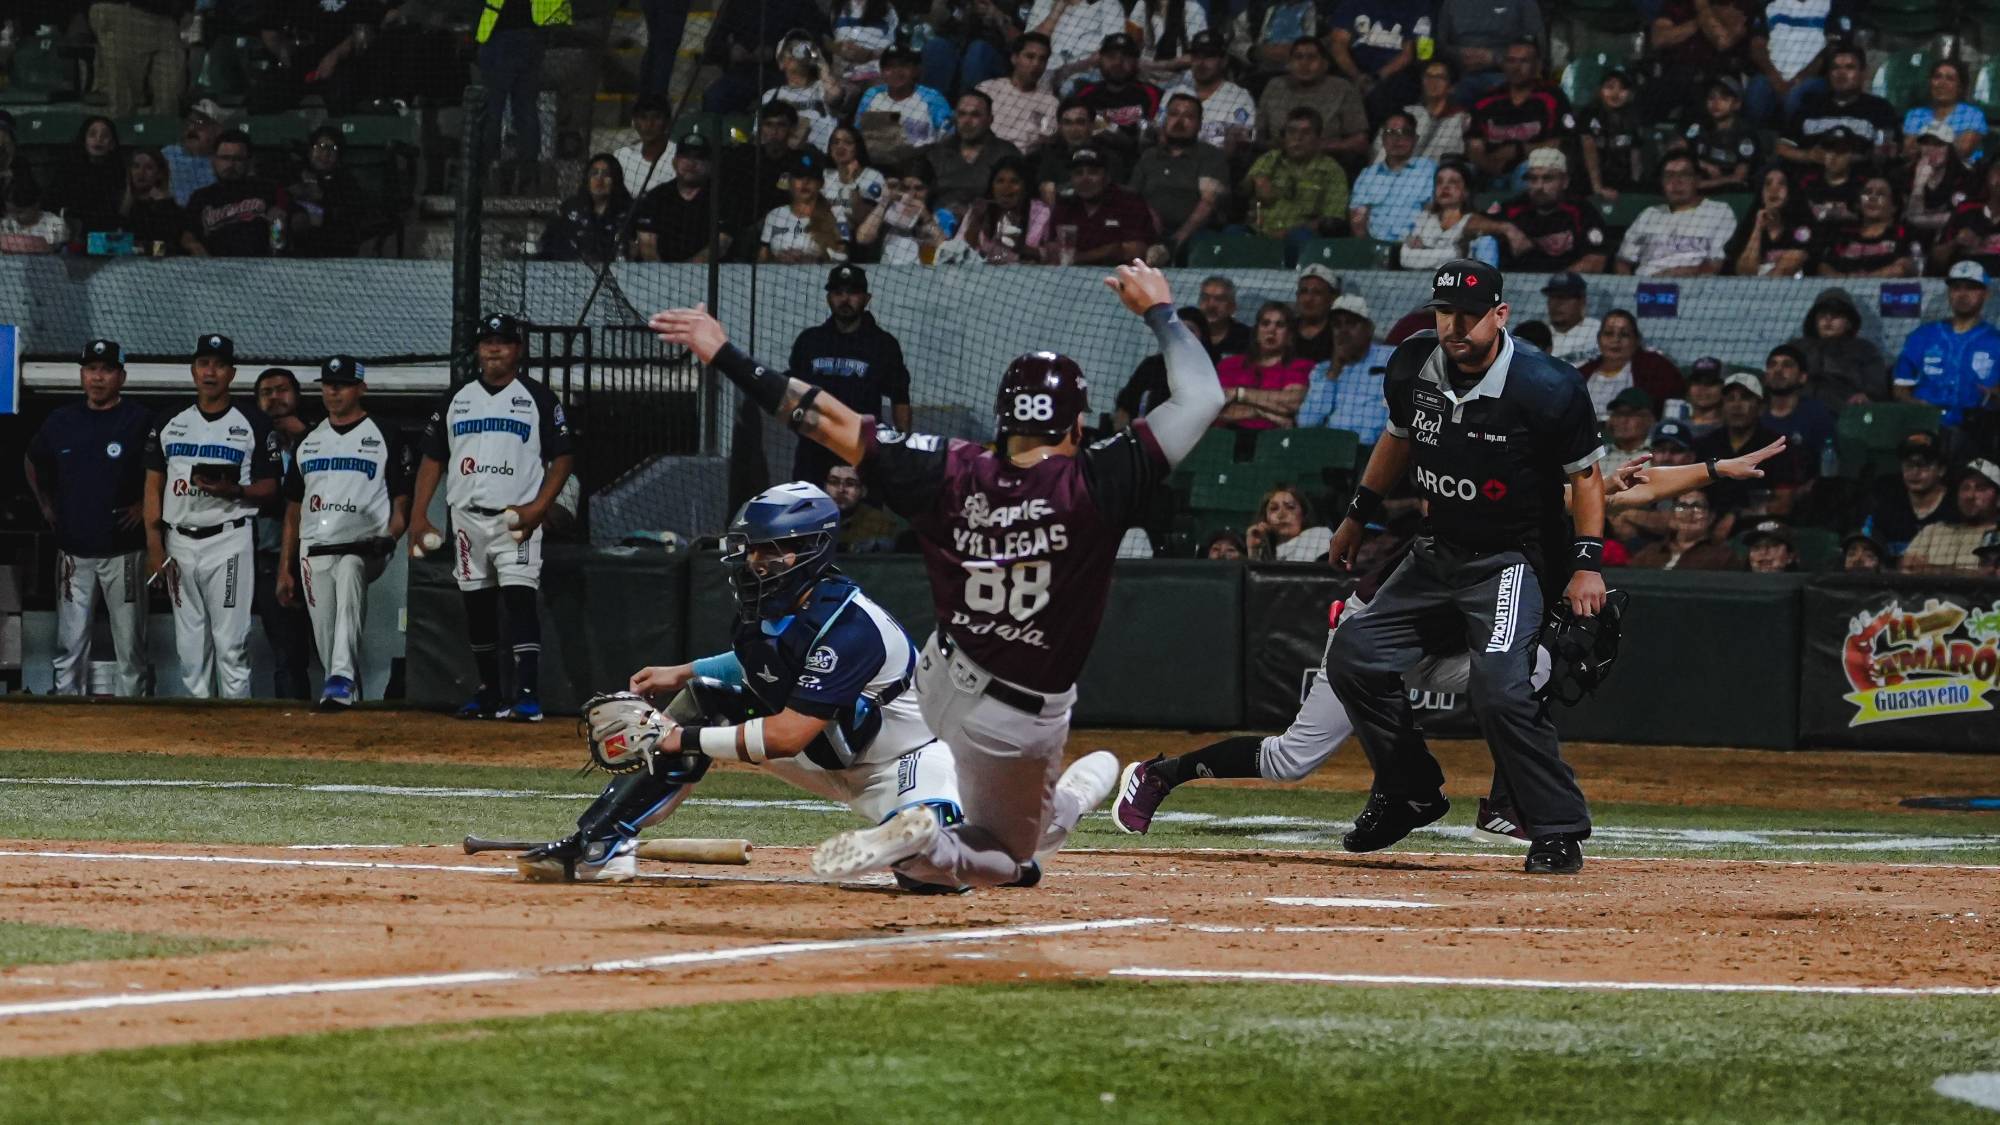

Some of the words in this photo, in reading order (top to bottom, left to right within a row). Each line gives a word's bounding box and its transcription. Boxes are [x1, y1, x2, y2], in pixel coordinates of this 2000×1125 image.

[1013, 393, 1053, 421] 88
[1411, 408, 1443, 435] Red
[1416, 430, 1439, 447] Cola
[461, 456, 514, 476] Kuroda
[1416, 465, 1477, 501] ARCO
[310, 494, 357, 513] Kuroda
[953, 523, 1069, 561] VILLEGAS
[961, 560, 1051, 622] 88
[1490, 565, 1515, 645] PAQUETEXPRESS
